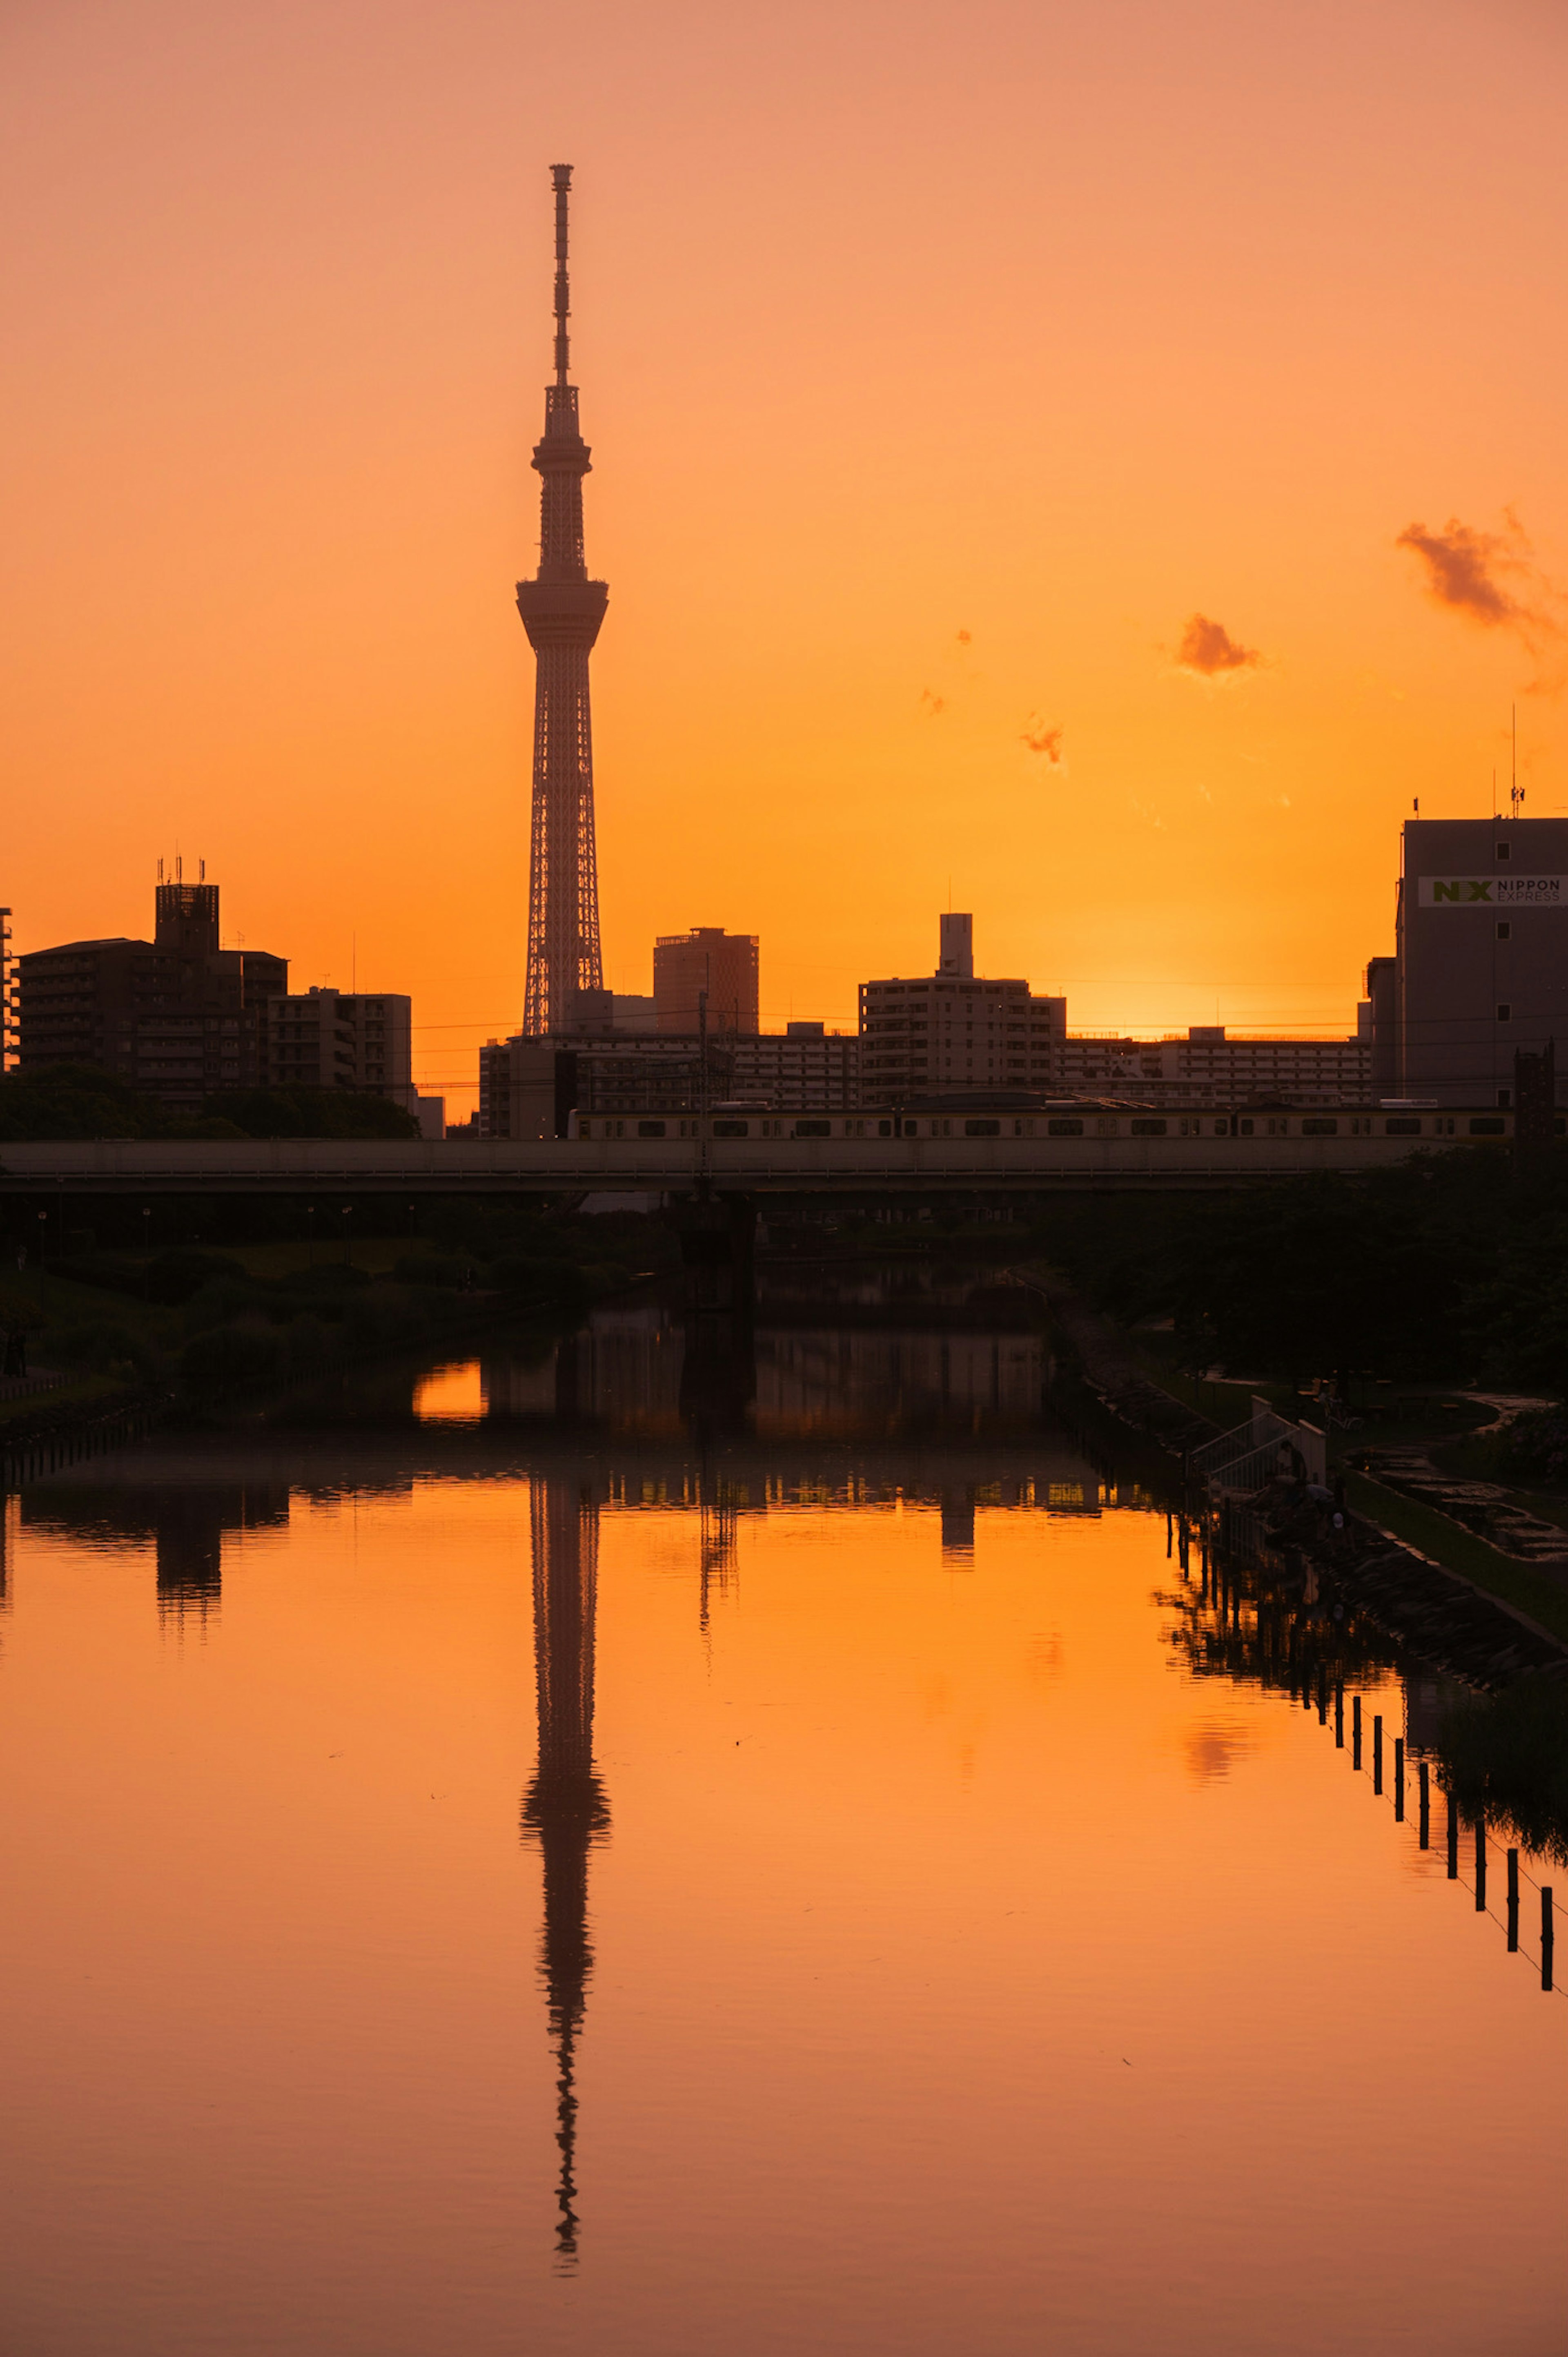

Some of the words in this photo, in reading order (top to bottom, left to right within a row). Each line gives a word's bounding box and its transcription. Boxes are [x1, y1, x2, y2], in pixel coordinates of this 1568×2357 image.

[1434, 881, 1493, 901] NX
[1498, 881, 1559, 891] NIPPON
[1498, 892, 1559, 901] EXPRESS
